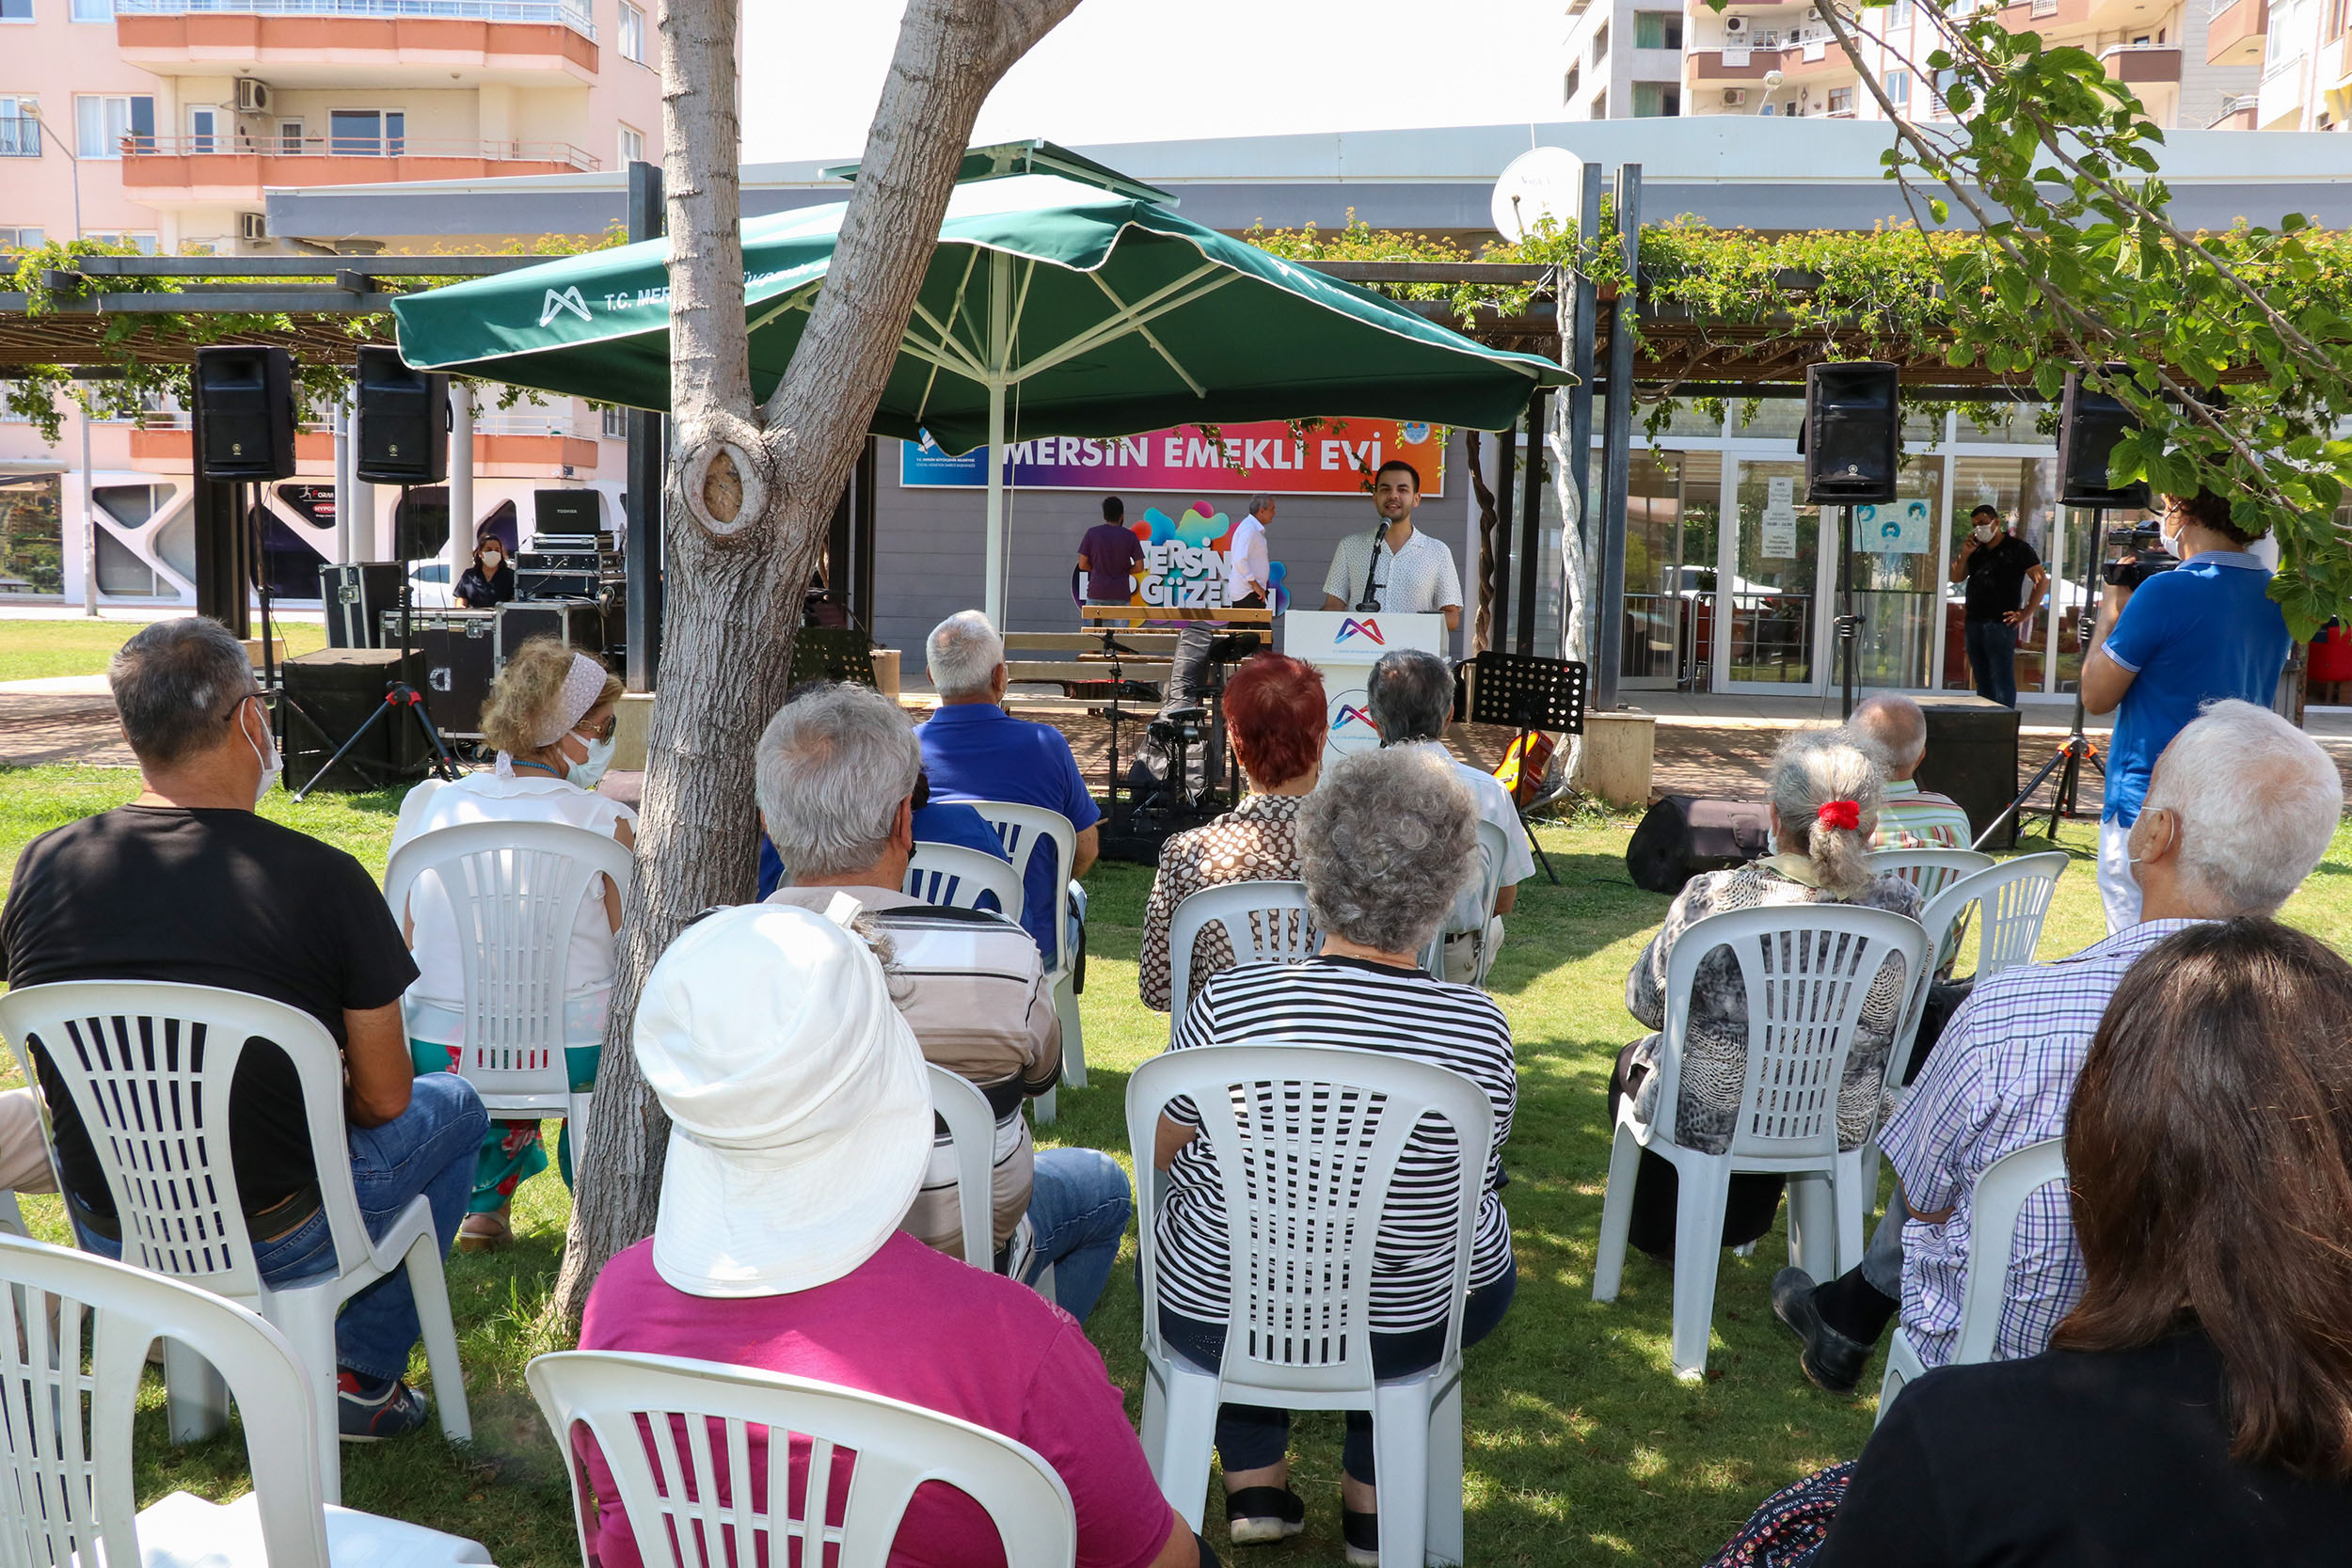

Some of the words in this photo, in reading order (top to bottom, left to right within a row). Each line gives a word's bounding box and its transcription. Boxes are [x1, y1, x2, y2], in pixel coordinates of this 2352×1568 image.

[605, 293, 632, 311] T.C.
[637, 286, 671, 308] MER
[1164, 430, 1304, 470] EMEKLİ
[1321, 431, 1382, 471] EVİ
